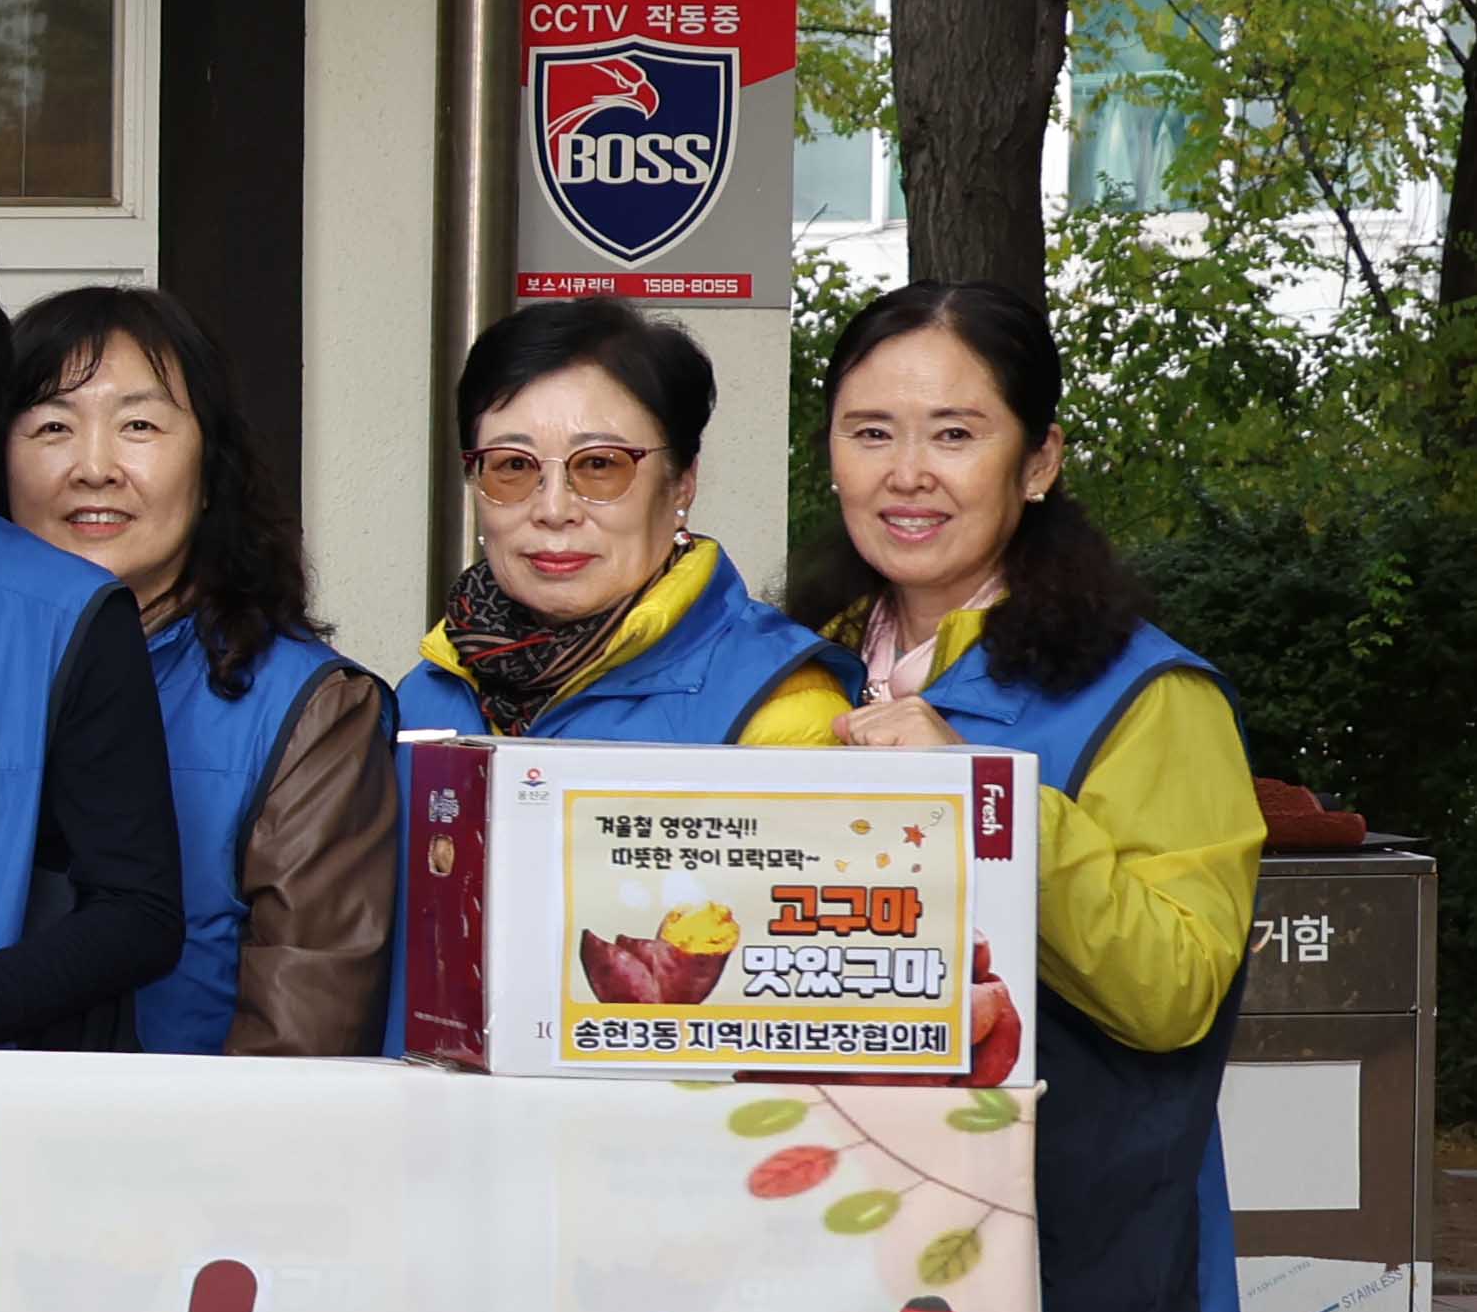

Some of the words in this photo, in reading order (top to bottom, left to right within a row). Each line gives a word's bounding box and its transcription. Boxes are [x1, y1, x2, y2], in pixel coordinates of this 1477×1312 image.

[529, 4, 628, 32] CCTV
[646, 4, 741, 34] 작동중
[558, 133, 712, 185] BOSS
[525, 278, 615, 294] 보스시큐리티
[643, 278, 739, 294] 1588-8055
[594, 814, 653, 838] 겨울철
[659, 815, 757, 840] 영양간식!!
[981, 783, 1005, 836] Fresh
[610, 845, 673, 870] 따뜻한
[678, 847, 720, 871] 정이
[726, 847, 819, 871] 모락모락~
[767, 885, 920, 939] 고구마
[1252, 914, 1334, 962] 거함
[741, 947, 945, 999] 맛있구마
[574, 1019, 679, 1049] 송현3동
[687, 1020, 947, 1052] 지역사회보장협의체
[1341, 1270, 1404, 1310] STAINLESS
